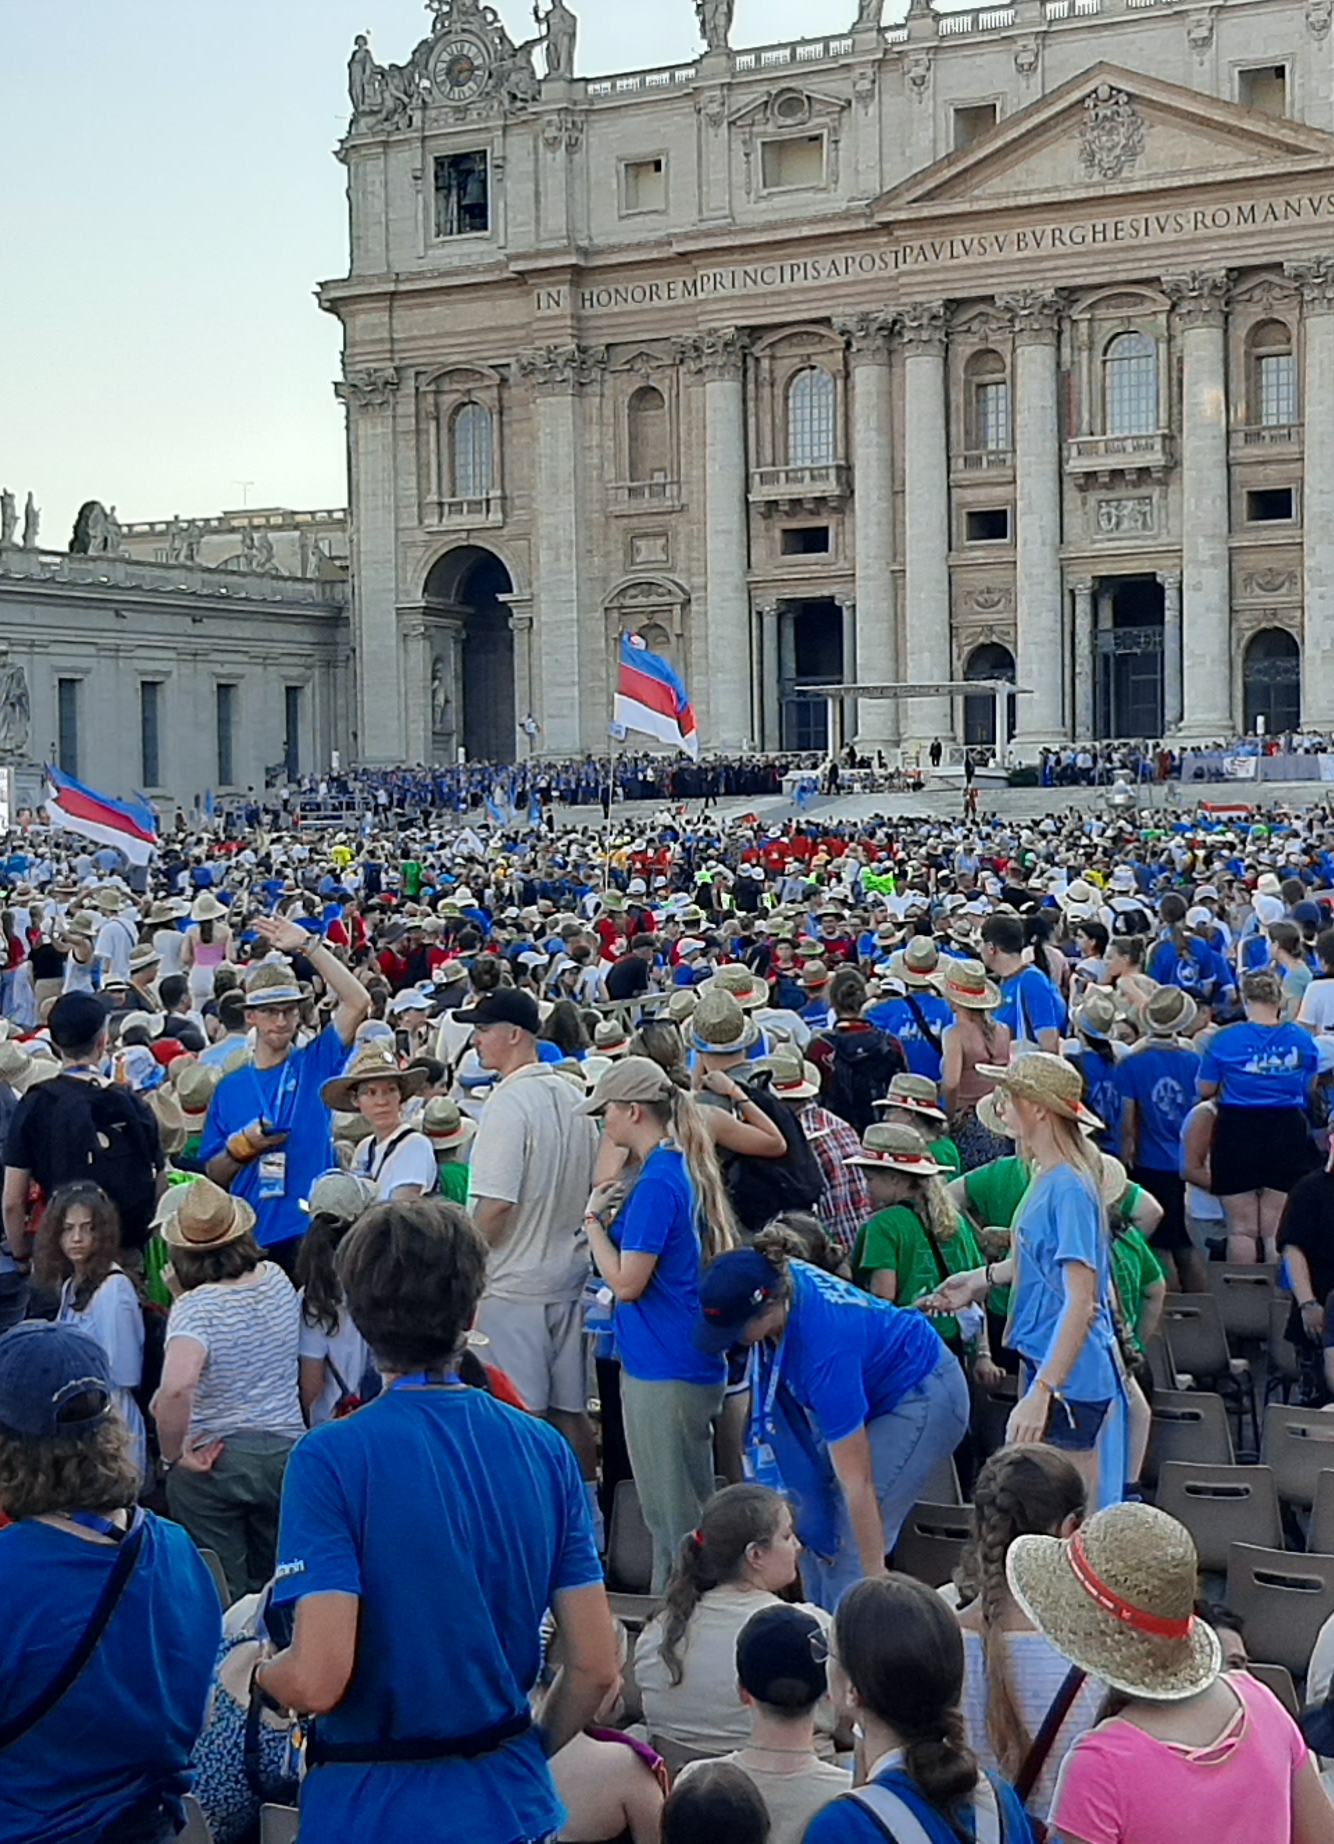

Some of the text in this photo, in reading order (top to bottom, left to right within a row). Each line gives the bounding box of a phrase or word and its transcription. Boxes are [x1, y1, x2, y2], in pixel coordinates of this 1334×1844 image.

[536, 289, 562, 310] IN
[580, 278, 698, 310] HONOREM
[699, 259, 821, 292] PRINCIPIS
